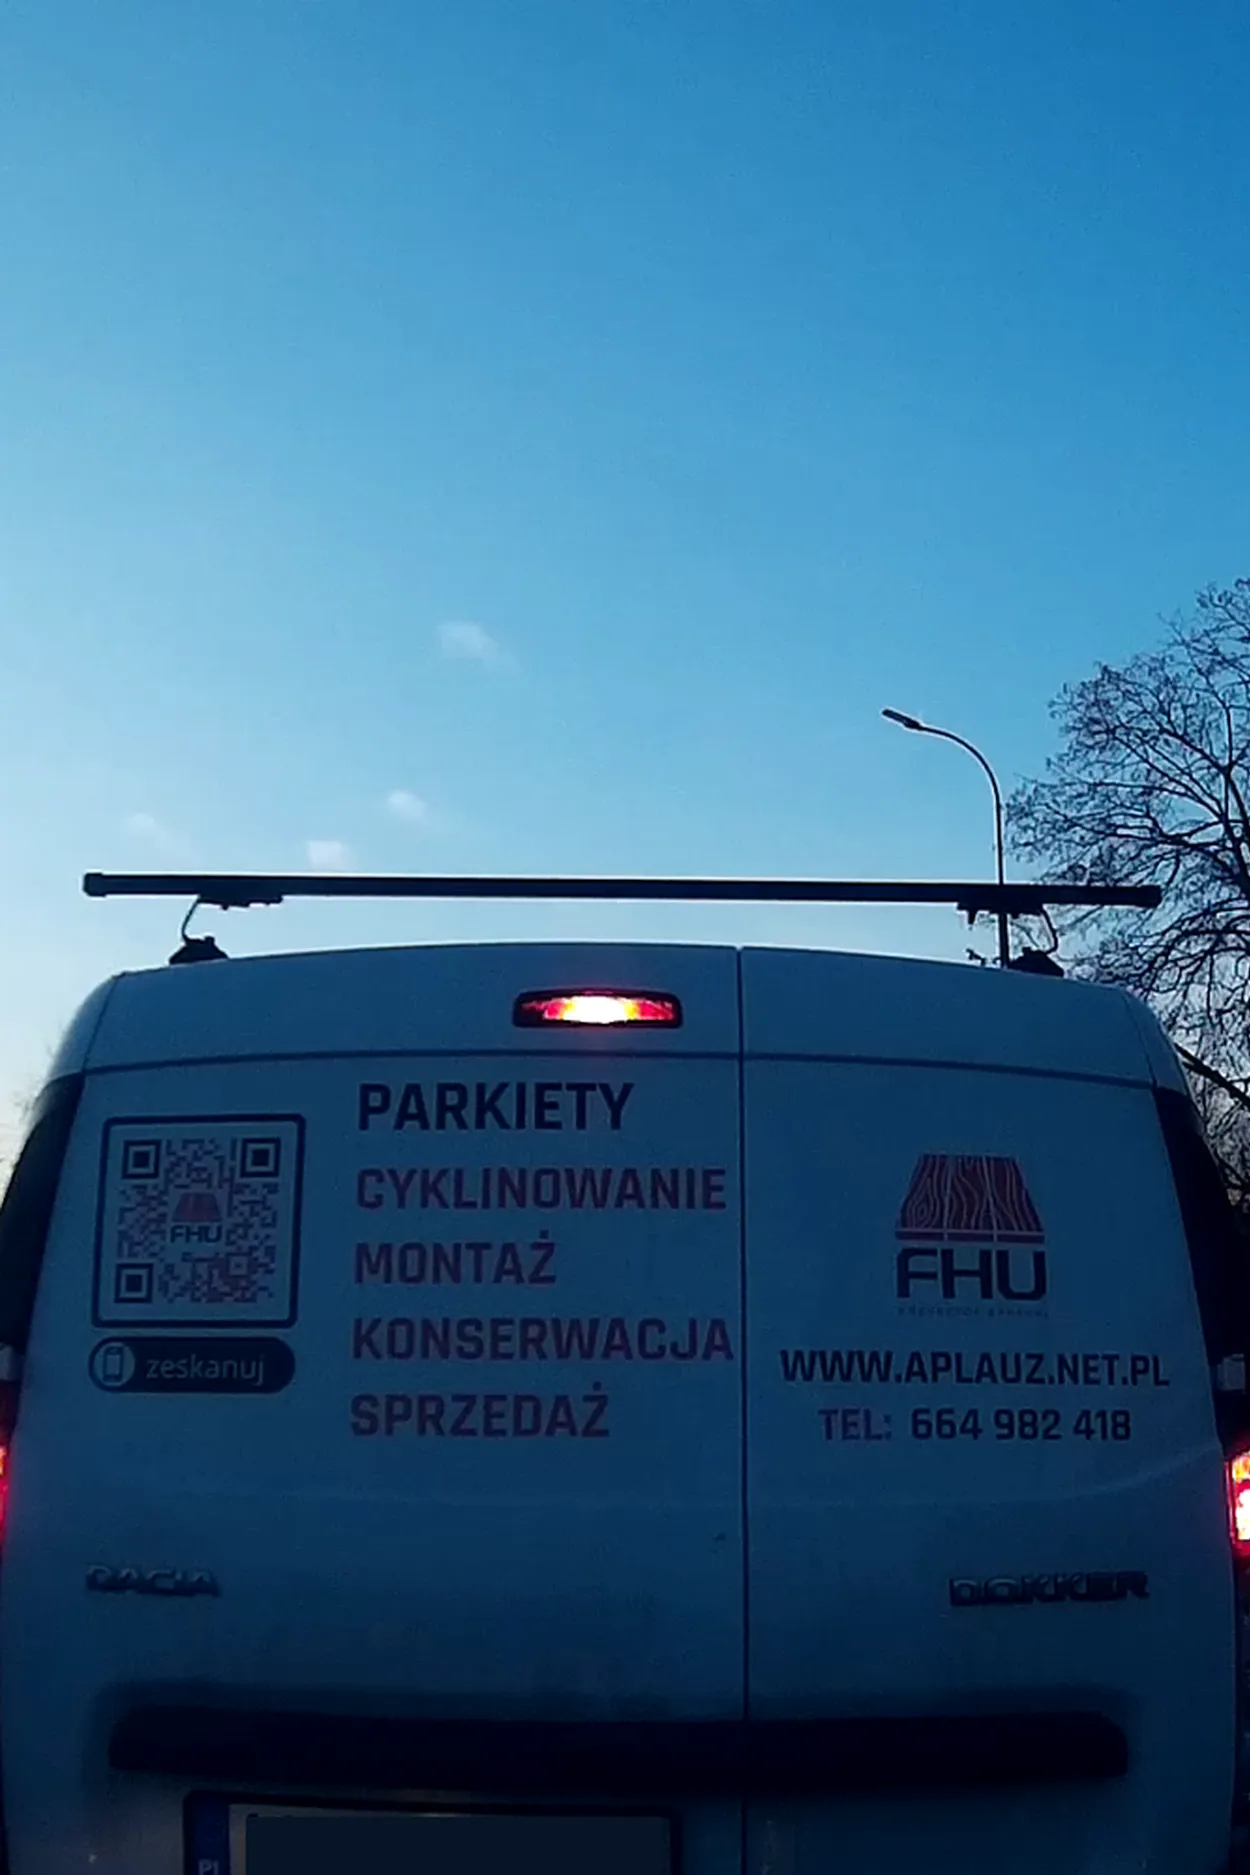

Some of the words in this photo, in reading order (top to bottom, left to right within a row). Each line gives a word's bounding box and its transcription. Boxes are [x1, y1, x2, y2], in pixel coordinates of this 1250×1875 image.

[358, 1082, 634, 1131] PARKIETY
[355, 1167, 727, 1211] CYKLINOWANIE
[169, 1223, 223, 1245] FHU
[354, 1230, 557, 1285] MONTAŻ
[897, 1248, 1046, 1301] FHU
[352, 1317, 734, 1361] KONSERWACJA
[145, 1351, 264, 1384] zeskanuj
[780, 1350, 1170, 1387] WWW.APLAUZ.NET.PL
[350, 1381, 609, 1438] SPRZEDAŻ
[818, 1408, 892, 1441] TEL:
[911, 1408, 982, 1440] 664
[995, 1409, 1062, 1441] 982
[1073, 1409, 1131, 1441] 418
